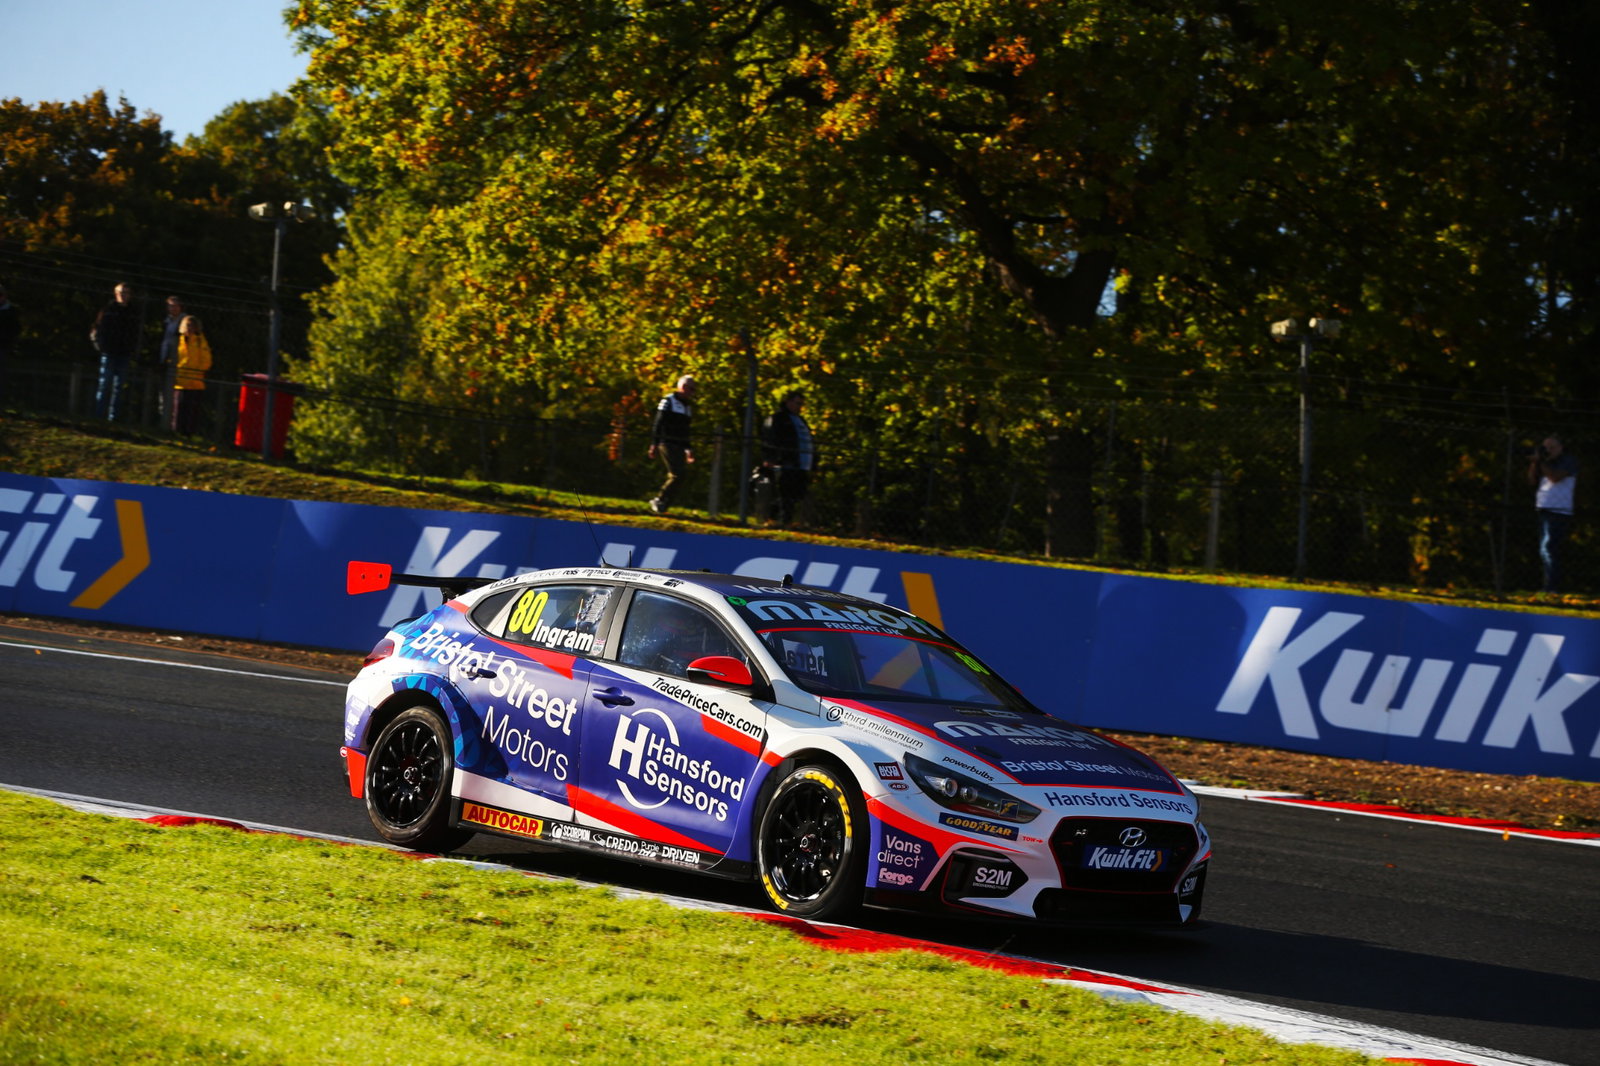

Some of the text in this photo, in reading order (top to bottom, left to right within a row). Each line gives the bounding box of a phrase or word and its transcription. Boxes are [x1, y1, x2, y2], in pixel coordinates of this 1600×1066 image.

[508, 589, 549, 634] 80
[532, 618, 594, 652] Ingram
[824, 621, 903, 637] FREIGHT UK
[409, 622, 578, 736] Bristol Street
[651, 677, 763, 738] TradePriceCars.com
[844, 711, 924, 749] third millennium
[481, 706, 569, 781] Motors
[647, 733, 745, 801] Hansford
[942, 755, 995, 783] powerbulbs
[1001, 760, 1064, 774] Bristol
[1064, 759, 1123, 776] Street
[643, 760, 729, 822] Sensors
[1044, 791, 1193, 815] Hansford Sensors
[467, 805, 539, 836] AUTOCAR
[946, 817, 1013, 837] GOODYEAR
[562, 824, 591, 842] SCORPION
[605, 835, 639, 853] CREDO
[886, 835, 922, 854] Vans
[661, 845, 700, 864] DRIVEN
[877, 850, 920, 869] direct
[878, 868, 914, 885] Forge
[974, 867, 1013, 886] S2M
